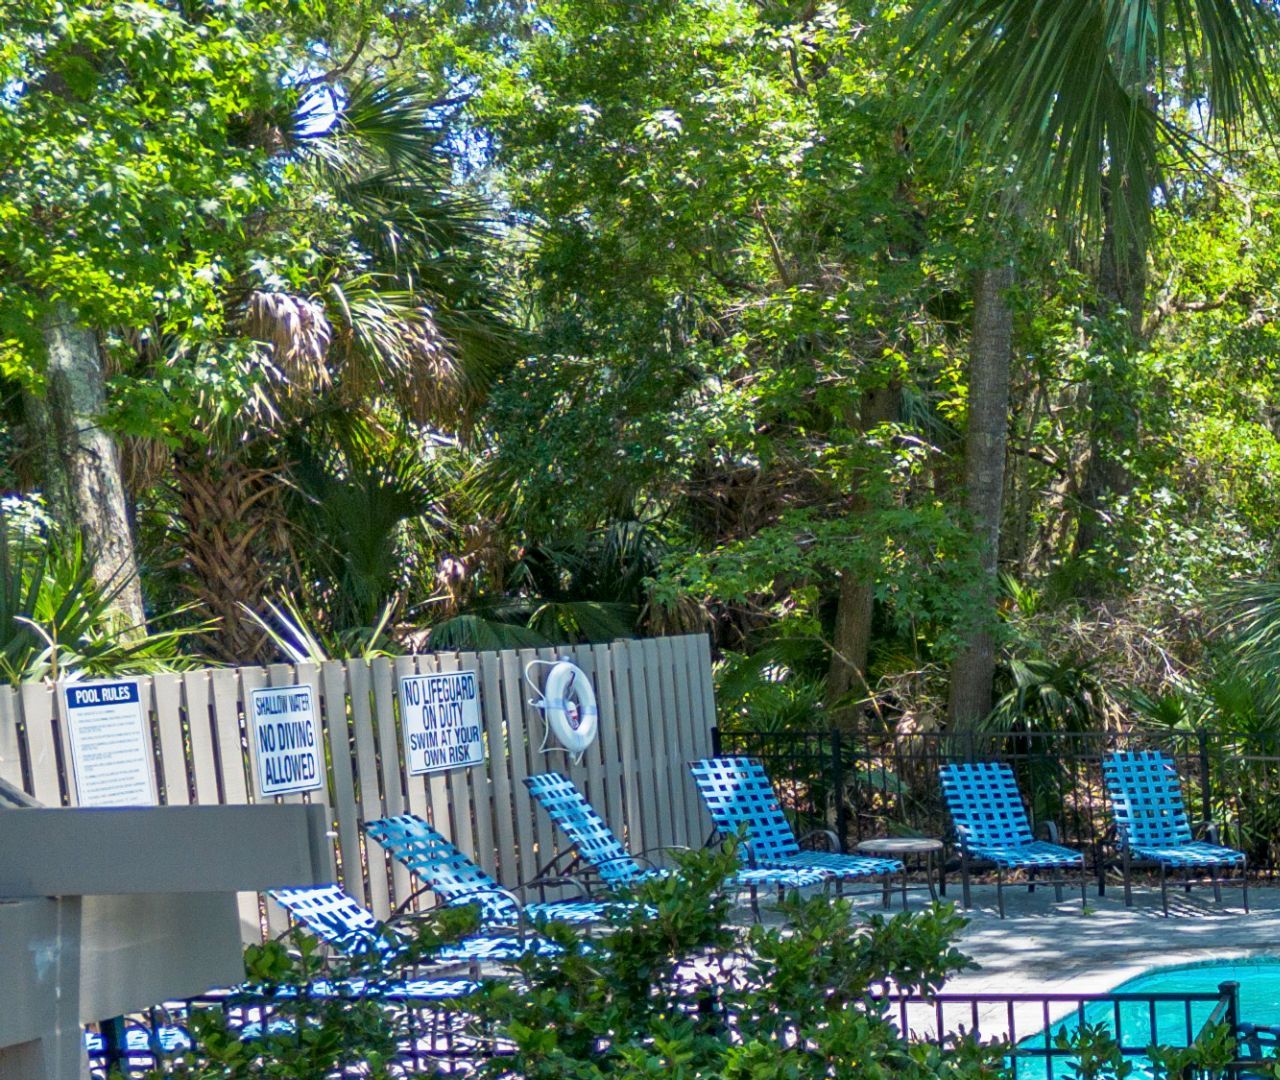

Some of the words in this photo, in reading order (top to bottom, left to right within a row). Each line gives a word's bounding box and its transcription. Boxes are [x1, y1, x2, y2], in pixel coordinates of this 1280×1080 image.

[75, 689, 101, 704] POOL
[101, 686, 131, 701] RULES
[288, 693, 311, 712] WATER
[404, 680, 420, 706] NO
[421, 676, 475, 704] LIFEGUARD
[422, 705, 438, 731] ON
[438, 702, 463, 728] DUTY
[258, 723, 276, 753] NO
[277, 720, 314, 750] DIVING
[410, 731, 439, 751] SWIM
[441, 729, 453, 747] AT
[454, 726, 480, 744] YOUR
[265, 752, 315, 786] ALLOWED
[423, 748, 447, 767] OWN
[448, 744, 471, 764] RISK
